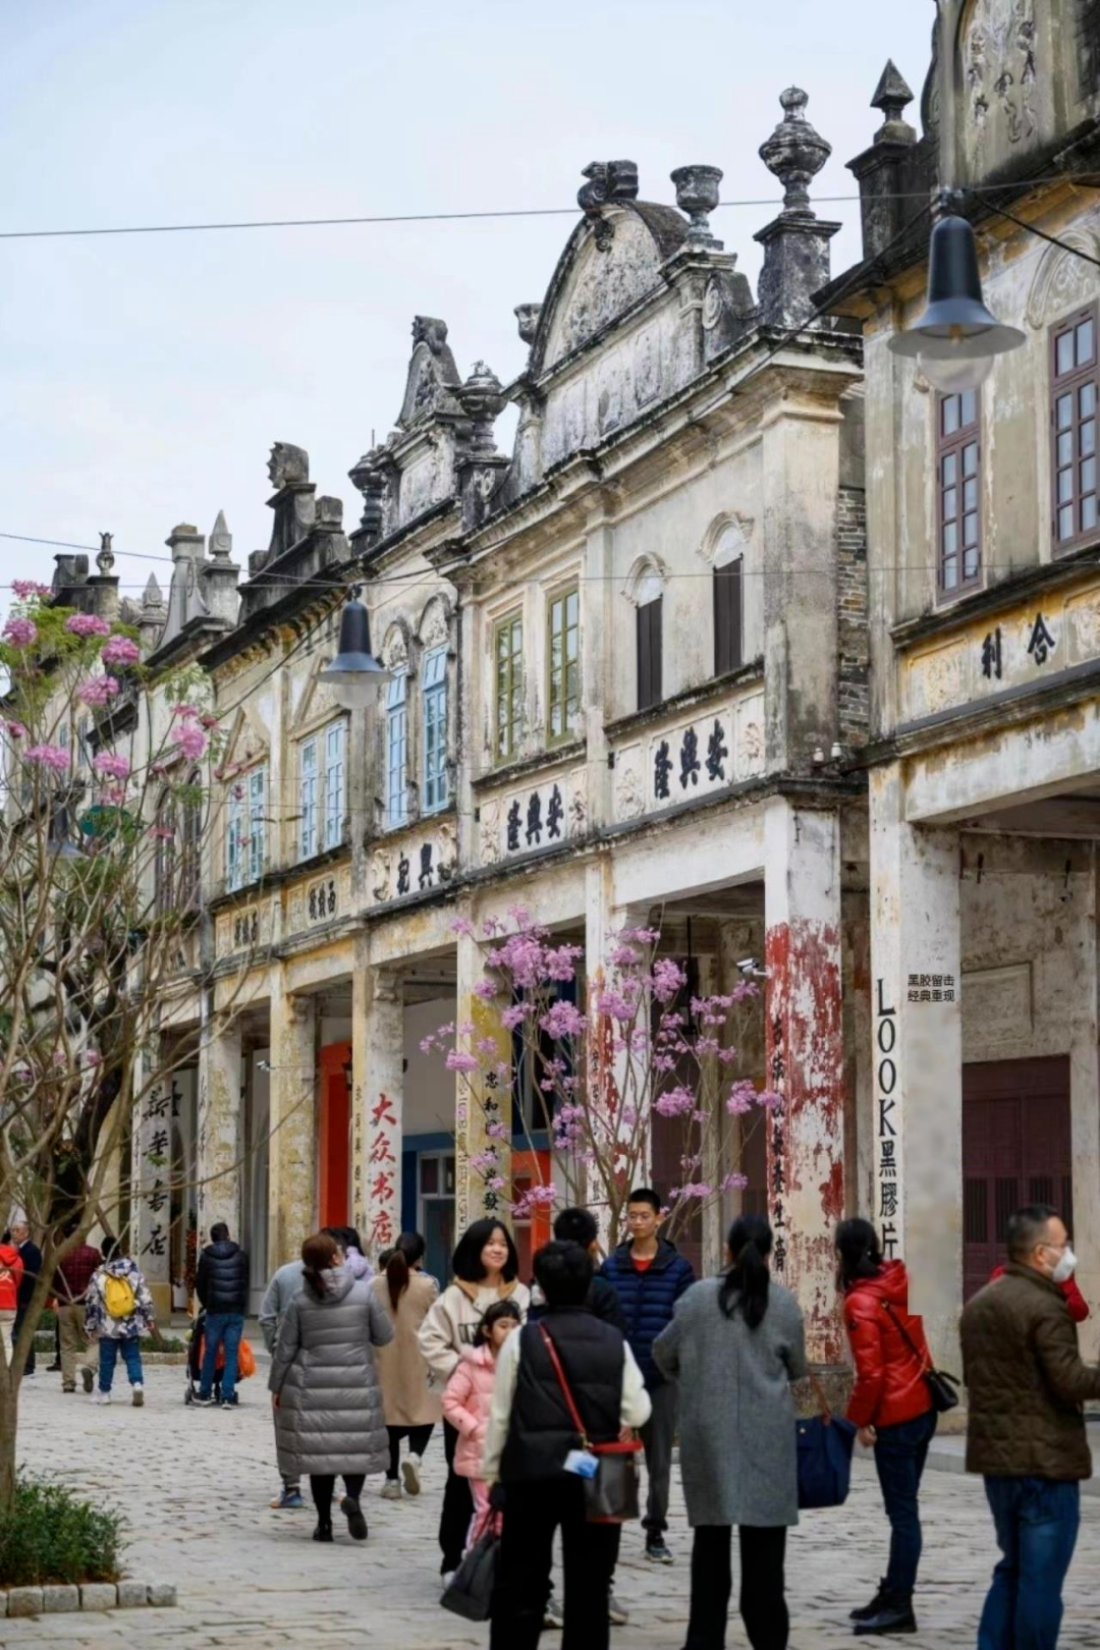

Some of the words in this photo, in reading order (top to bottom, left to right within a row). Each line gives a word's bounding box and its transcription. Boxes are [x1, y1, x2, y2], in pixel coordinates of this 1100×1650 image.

[907, 990, 955, 1003] 经典重现
[368, 1092, 398, 1245] 大众书店
